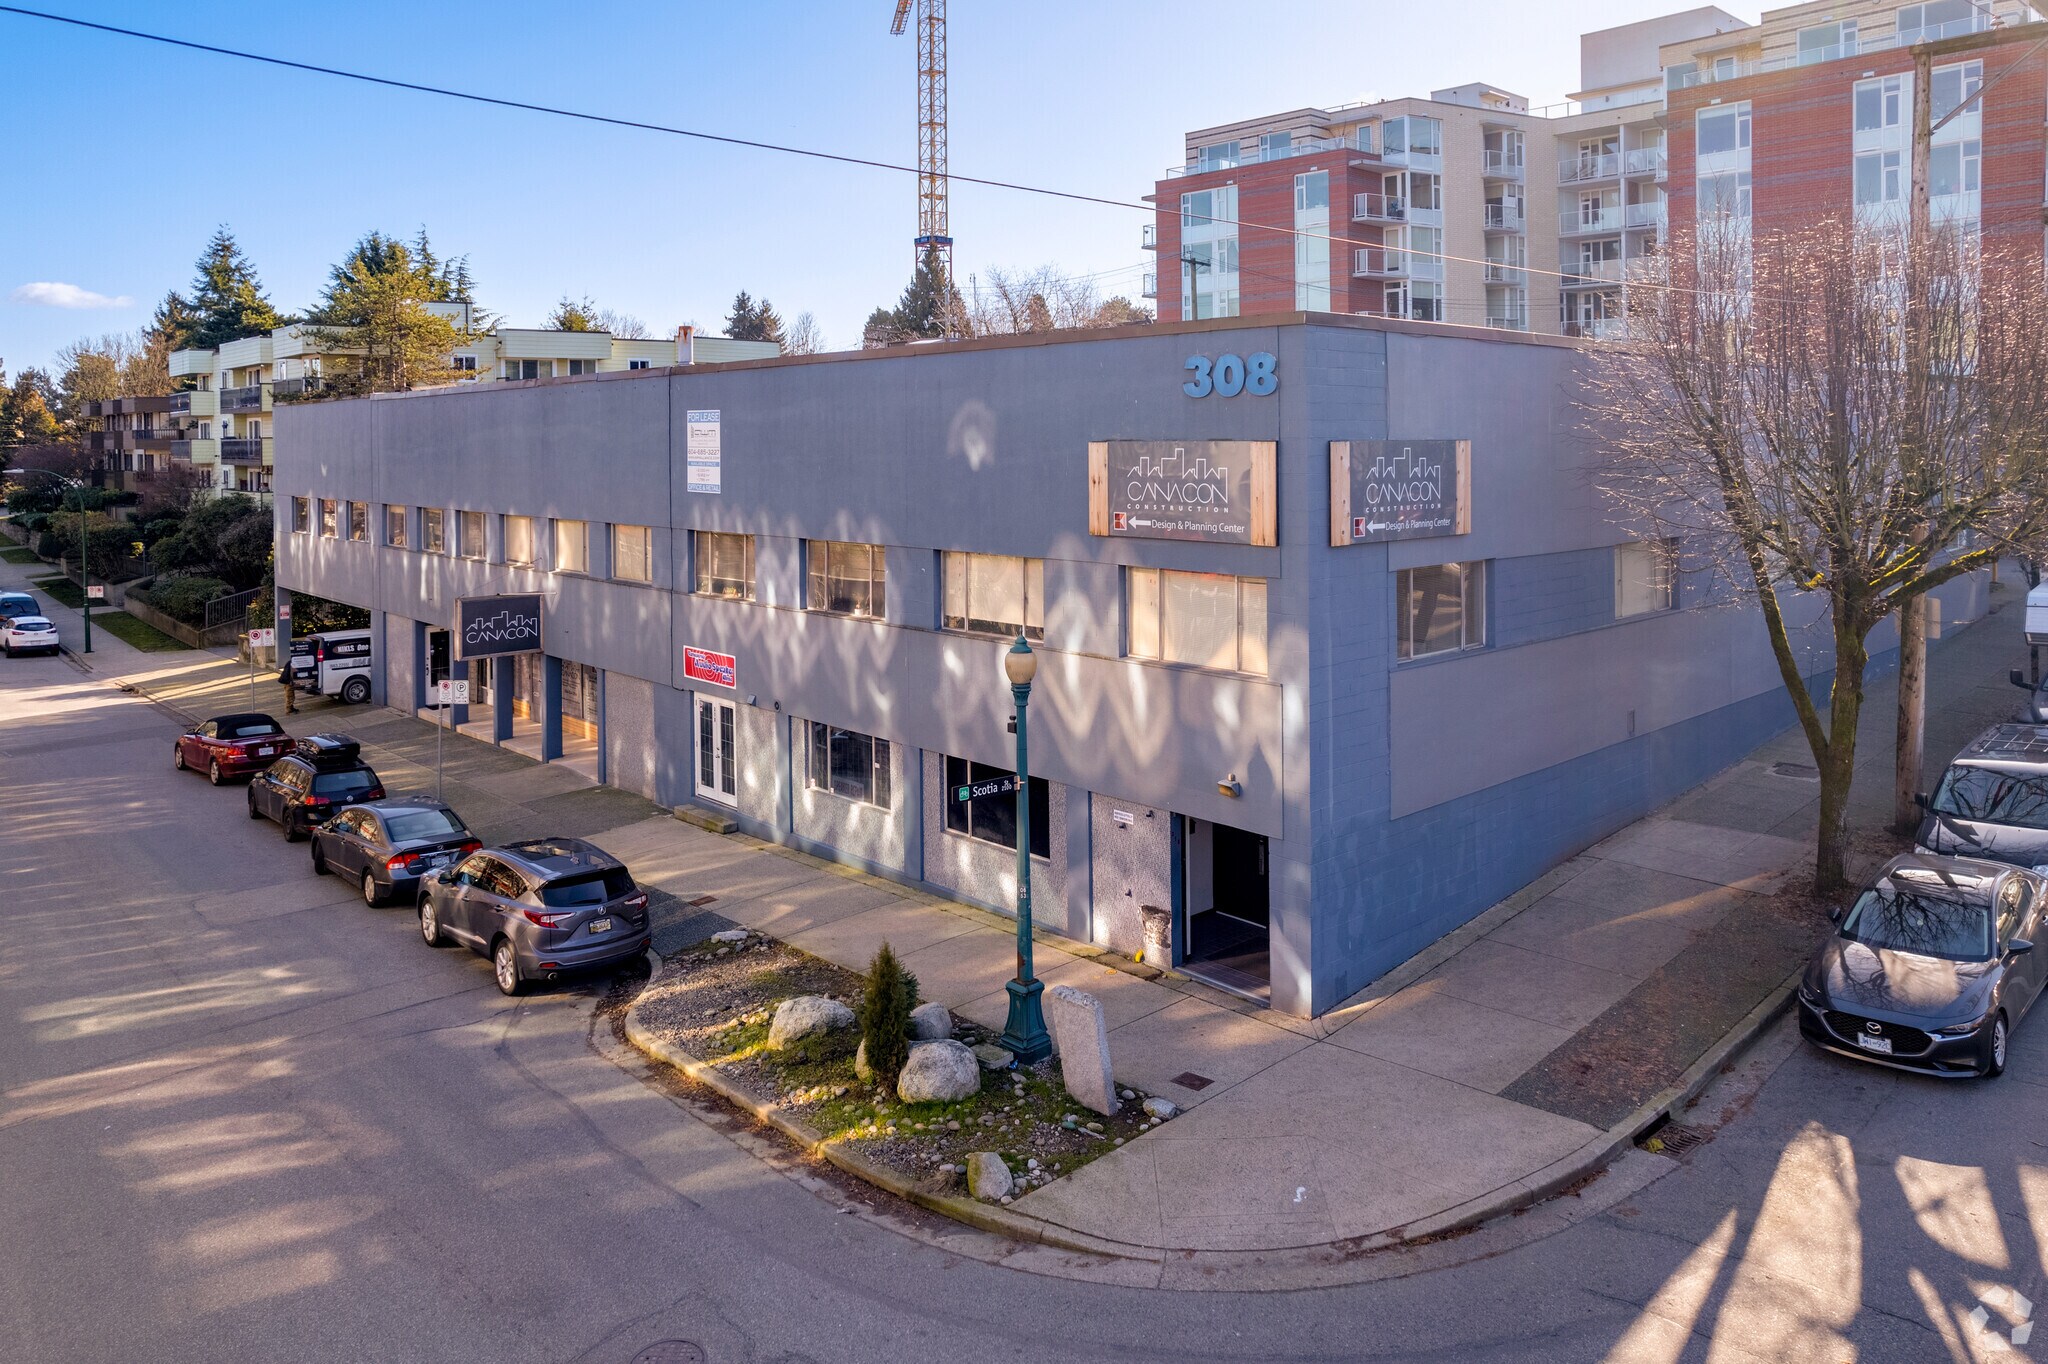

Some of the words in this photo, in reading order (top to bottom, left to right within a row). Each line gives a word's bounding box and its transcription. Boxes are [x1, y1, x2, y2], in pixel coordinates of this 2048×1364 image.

[1183, 352, 1278, 398] 308
[688, 412, 700, 421] FOR
[700, 412, 719, 421] LEASE
[1127, 481, 1228, 503] CANACON
[1366, 482, 1441, 504] CANACON
[1127, 503, 1229, 513] CONSTRUCTION
[1366, 503, 1441, 513] CONSTRUCTION
[1151, 519, 1176, 531] Design
[1178, 521, 1184, 530] &
[1185, 521, 1217, 533] Planning
[1219, 522, 1245, 533] Center
[1385, 521, 1405, 532] Design
[1406, 521, 1411, 529] &
[1411, 519, 1433, 530] Planning
[1434, 517, 1451, 527] Center
[466, 626, 538, 644] CANACON
[973, 782, 998, 797] Scotia
